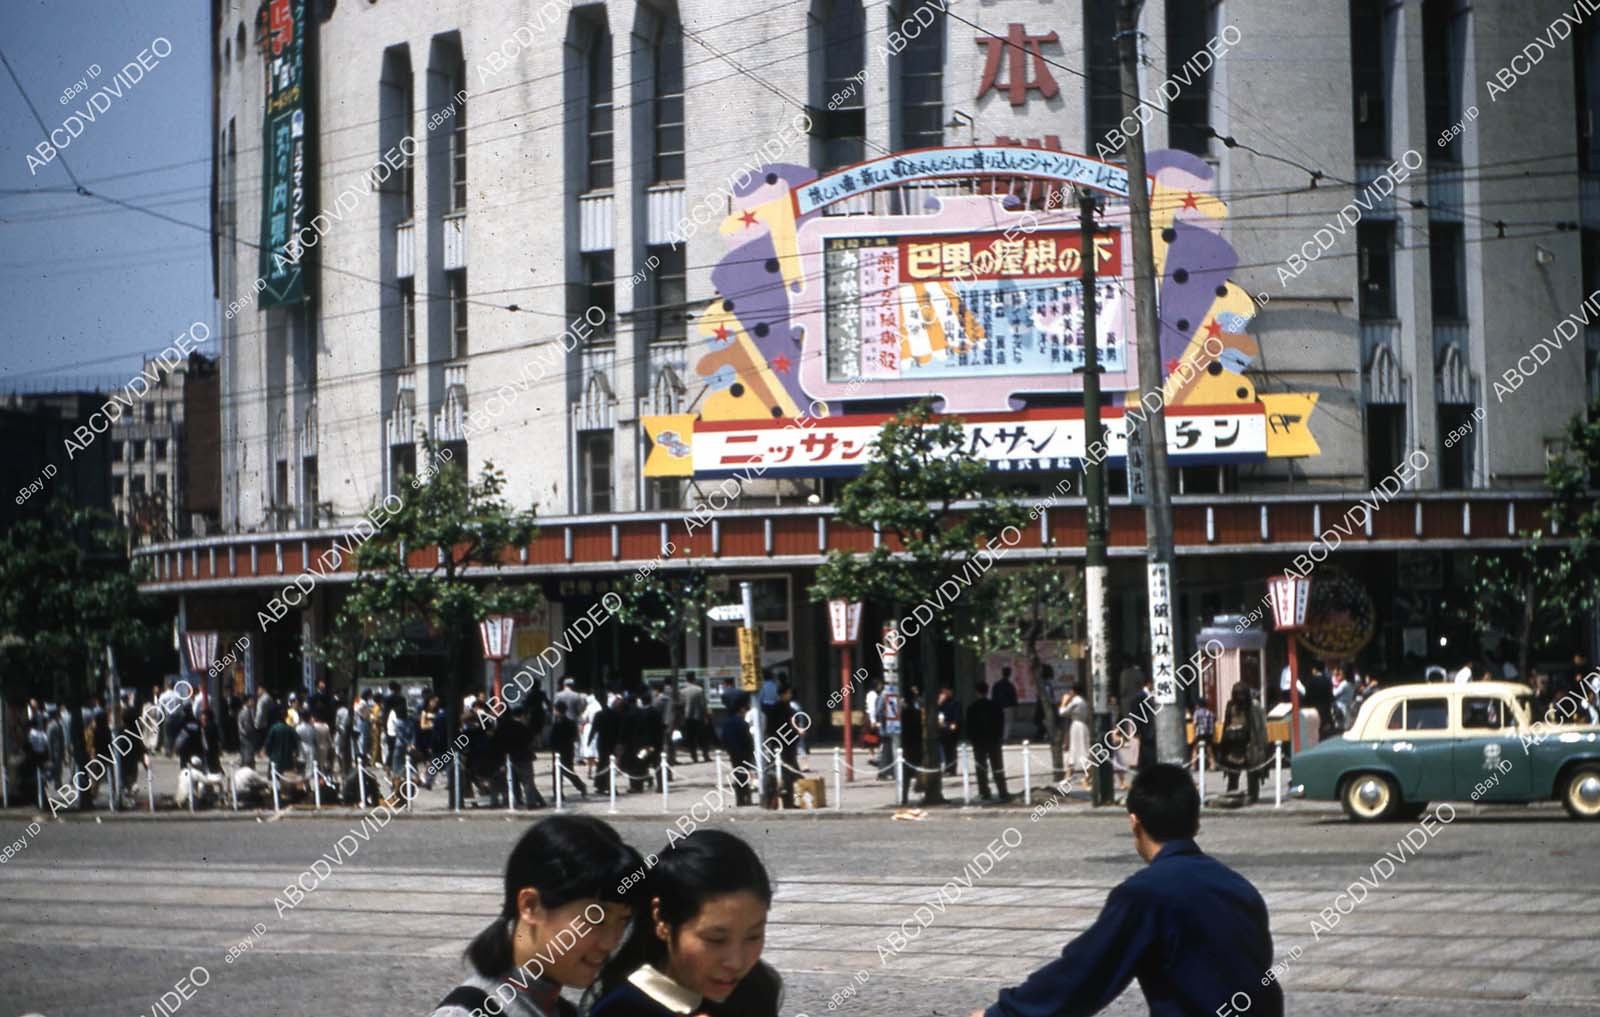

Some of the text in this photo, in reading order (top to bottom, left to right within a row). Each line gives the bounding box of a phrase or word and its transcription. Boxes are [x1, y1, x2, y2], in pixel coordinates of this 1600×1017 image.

[975, 23, 1059, 107] 本
[720, 428, 865, 471] ニッサン
